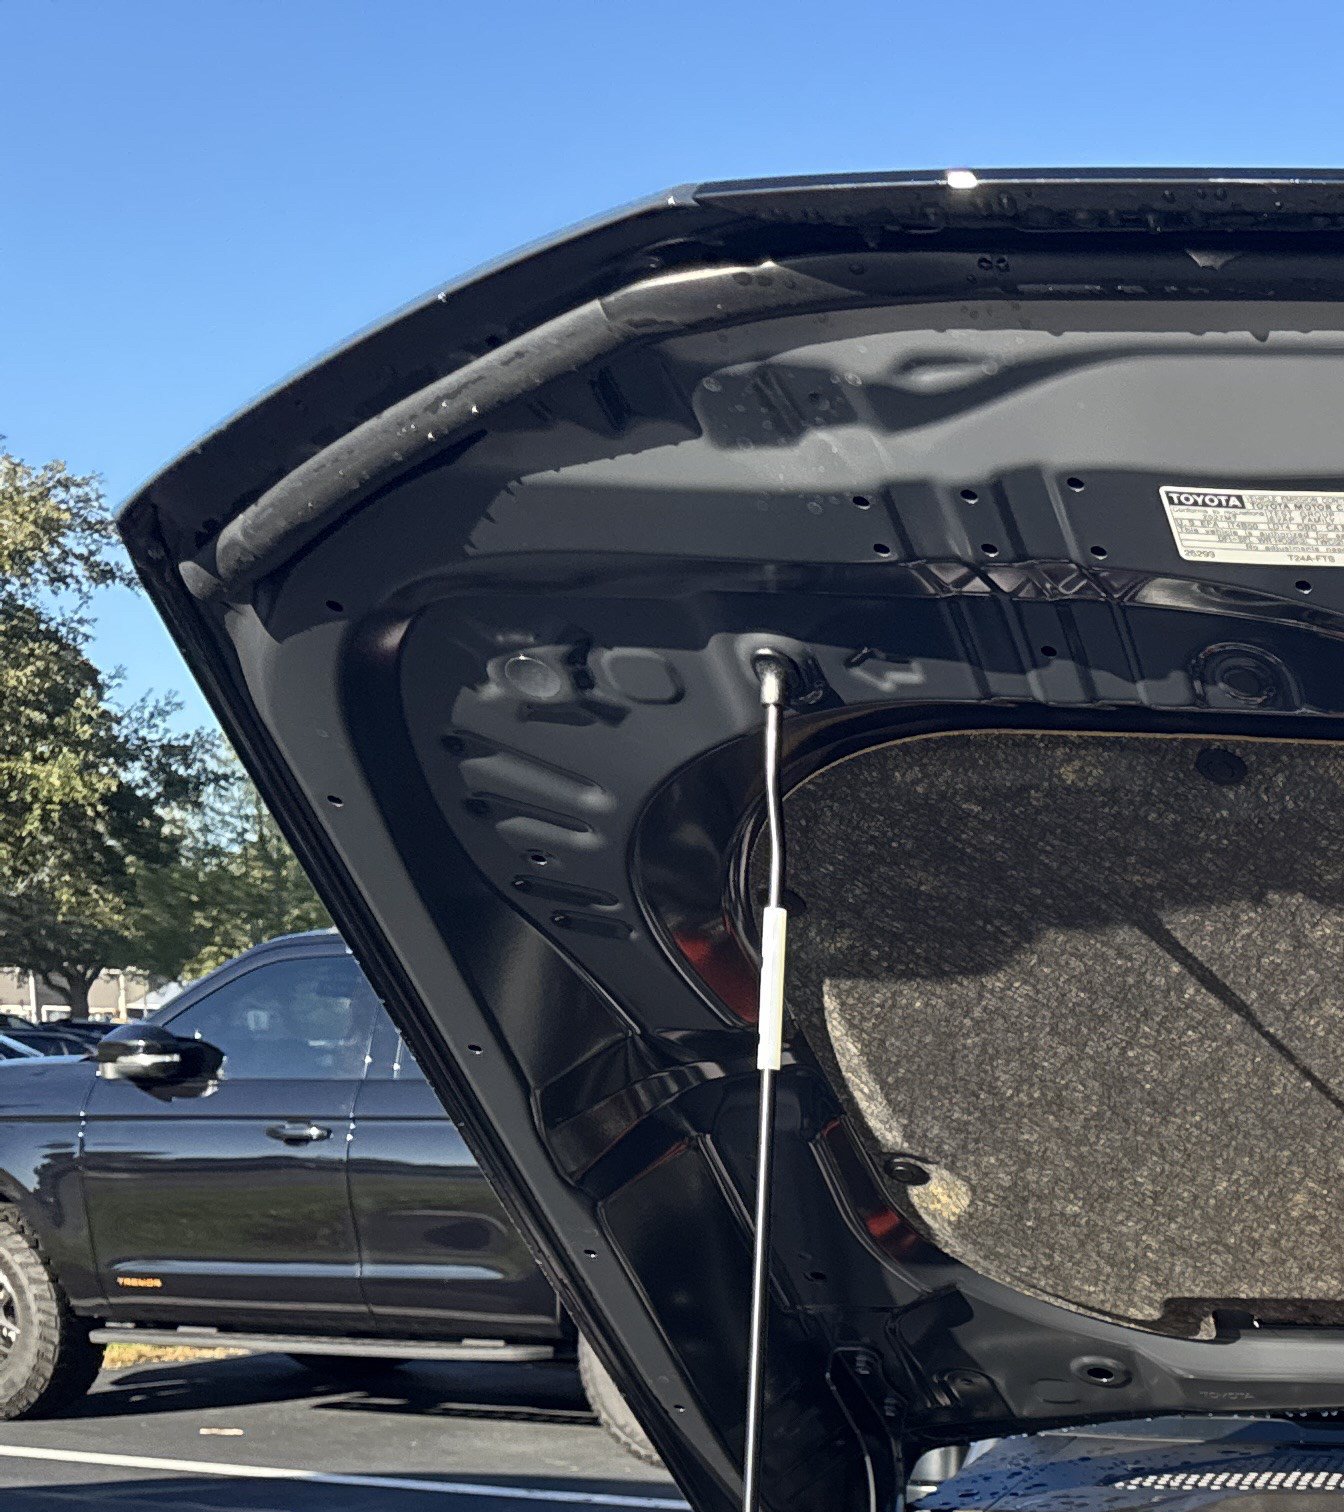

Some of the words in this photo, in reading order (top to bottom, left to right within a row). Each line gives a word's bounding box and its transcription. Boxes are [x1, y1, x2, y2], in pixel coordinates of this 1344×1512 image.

[1168, 492, 1242, 507] TOYOTA
[1251, 502, 1290, 510] TOYOTA
[1294, 503, 1332, 511] MOTOR
